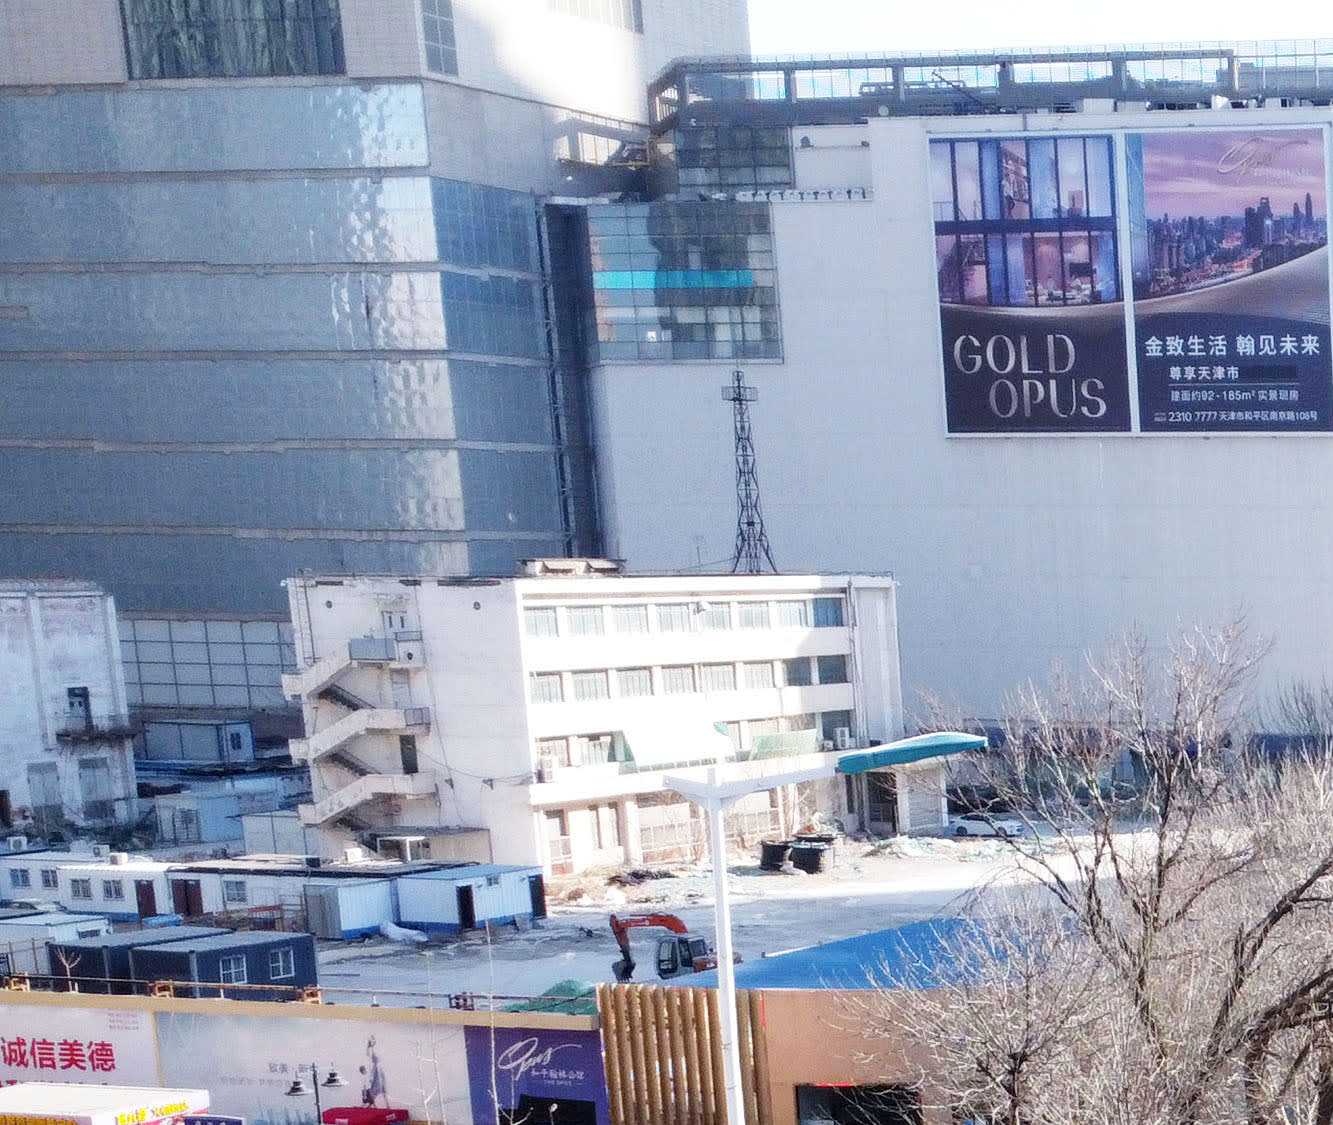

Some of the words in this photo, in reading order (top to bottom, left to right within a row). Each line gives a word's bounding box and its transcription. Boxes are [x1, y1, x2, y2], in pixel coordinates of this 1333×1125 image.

[953, 334, 1076, 375] GOLD
[1144, 334, 1228, 357] 金致生活
[1236, 334, 1321, 356] 翰见未来
[1169, 365, 1240, 381] 尊享天津市
[989, 378, 1107, 418] OPUS
[1168, 411, 1192, 422] 2310
[1194, 411, 1217, 422] 7777
[0, 1036, 116, 1072] 诚信美德
